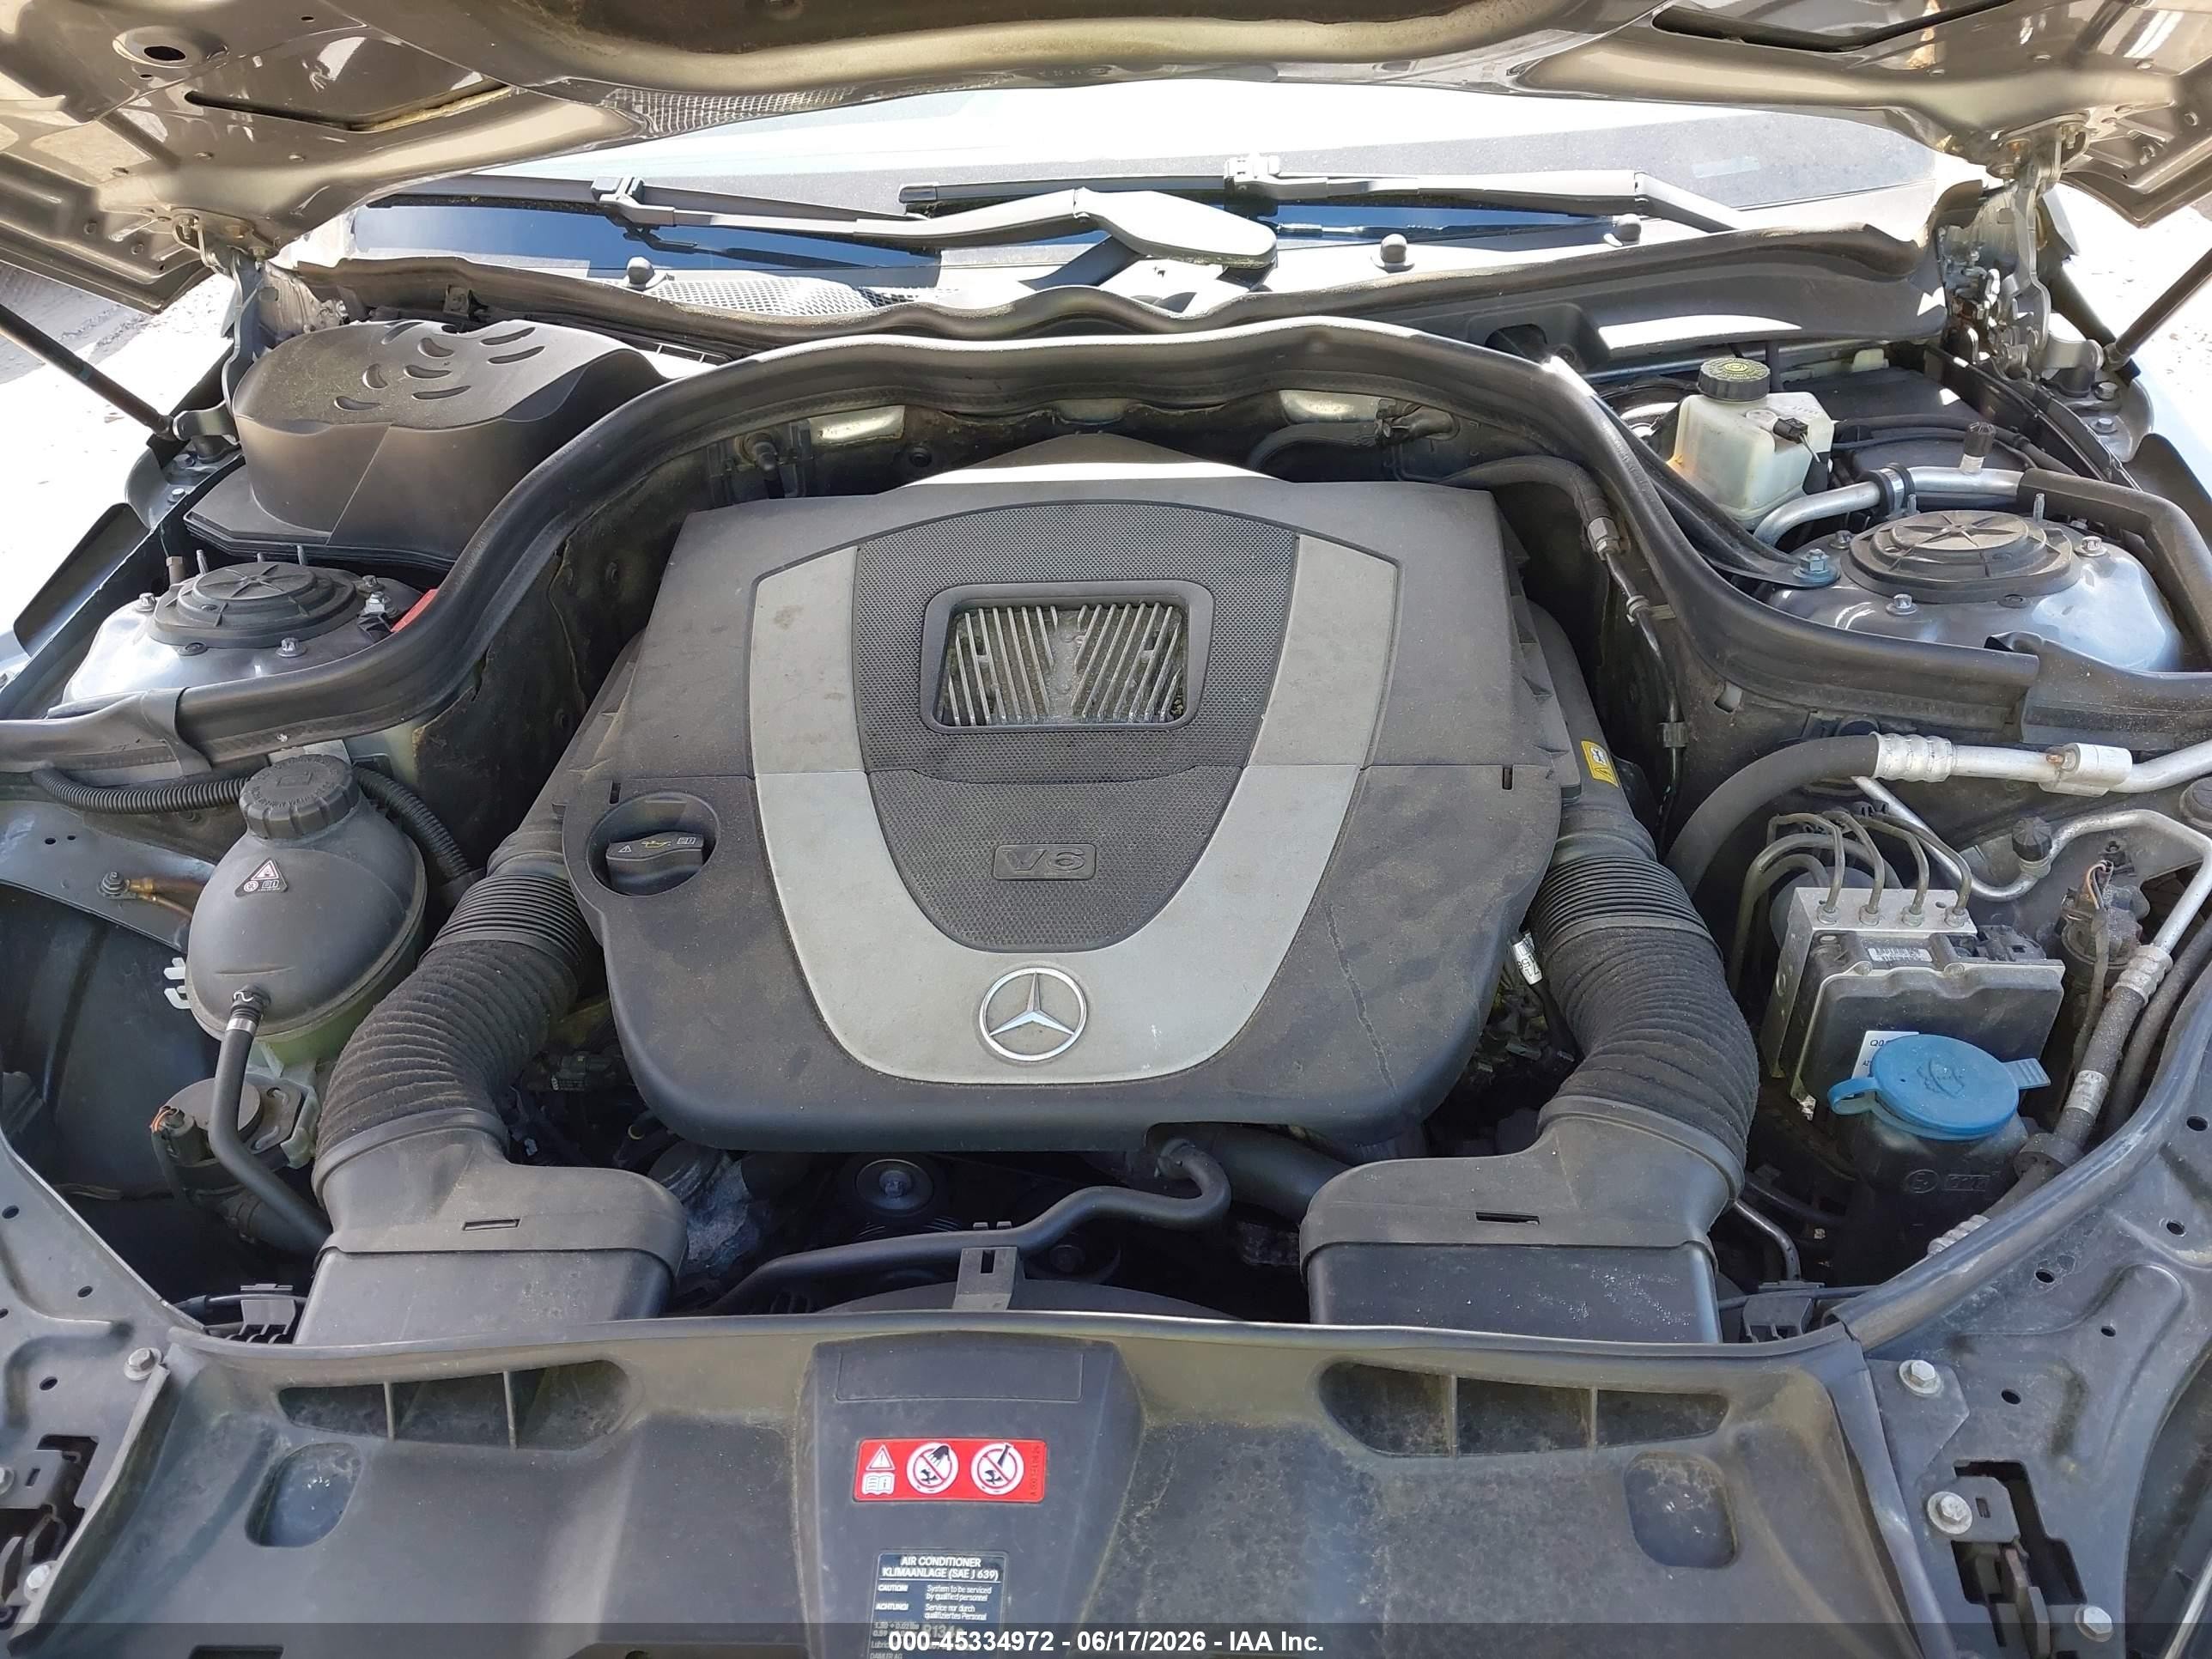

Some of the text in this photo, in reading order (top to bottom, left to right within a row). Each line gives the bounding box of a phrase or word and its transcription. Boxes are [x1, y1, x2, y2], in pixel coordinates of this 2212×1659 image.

[1001, 847, 1086, 872] V6
[900, 1557, 982, 1567] AIR CONDITIONER
[882, 1567, 999, 1581] KLIMAANLAGE (SAE J 639)
[927, 1584, 951, 1593] System
[967, 1585, 992, 1594] serviced
[925, 1592, 988, 1602] by qualified personnel
[925, 1603, 947, 1612] Service
[958, 1604, 975, 1613] durch
[962, 1613, 987, 1621] Personal
[921, 1624, 964, 1638] R134
